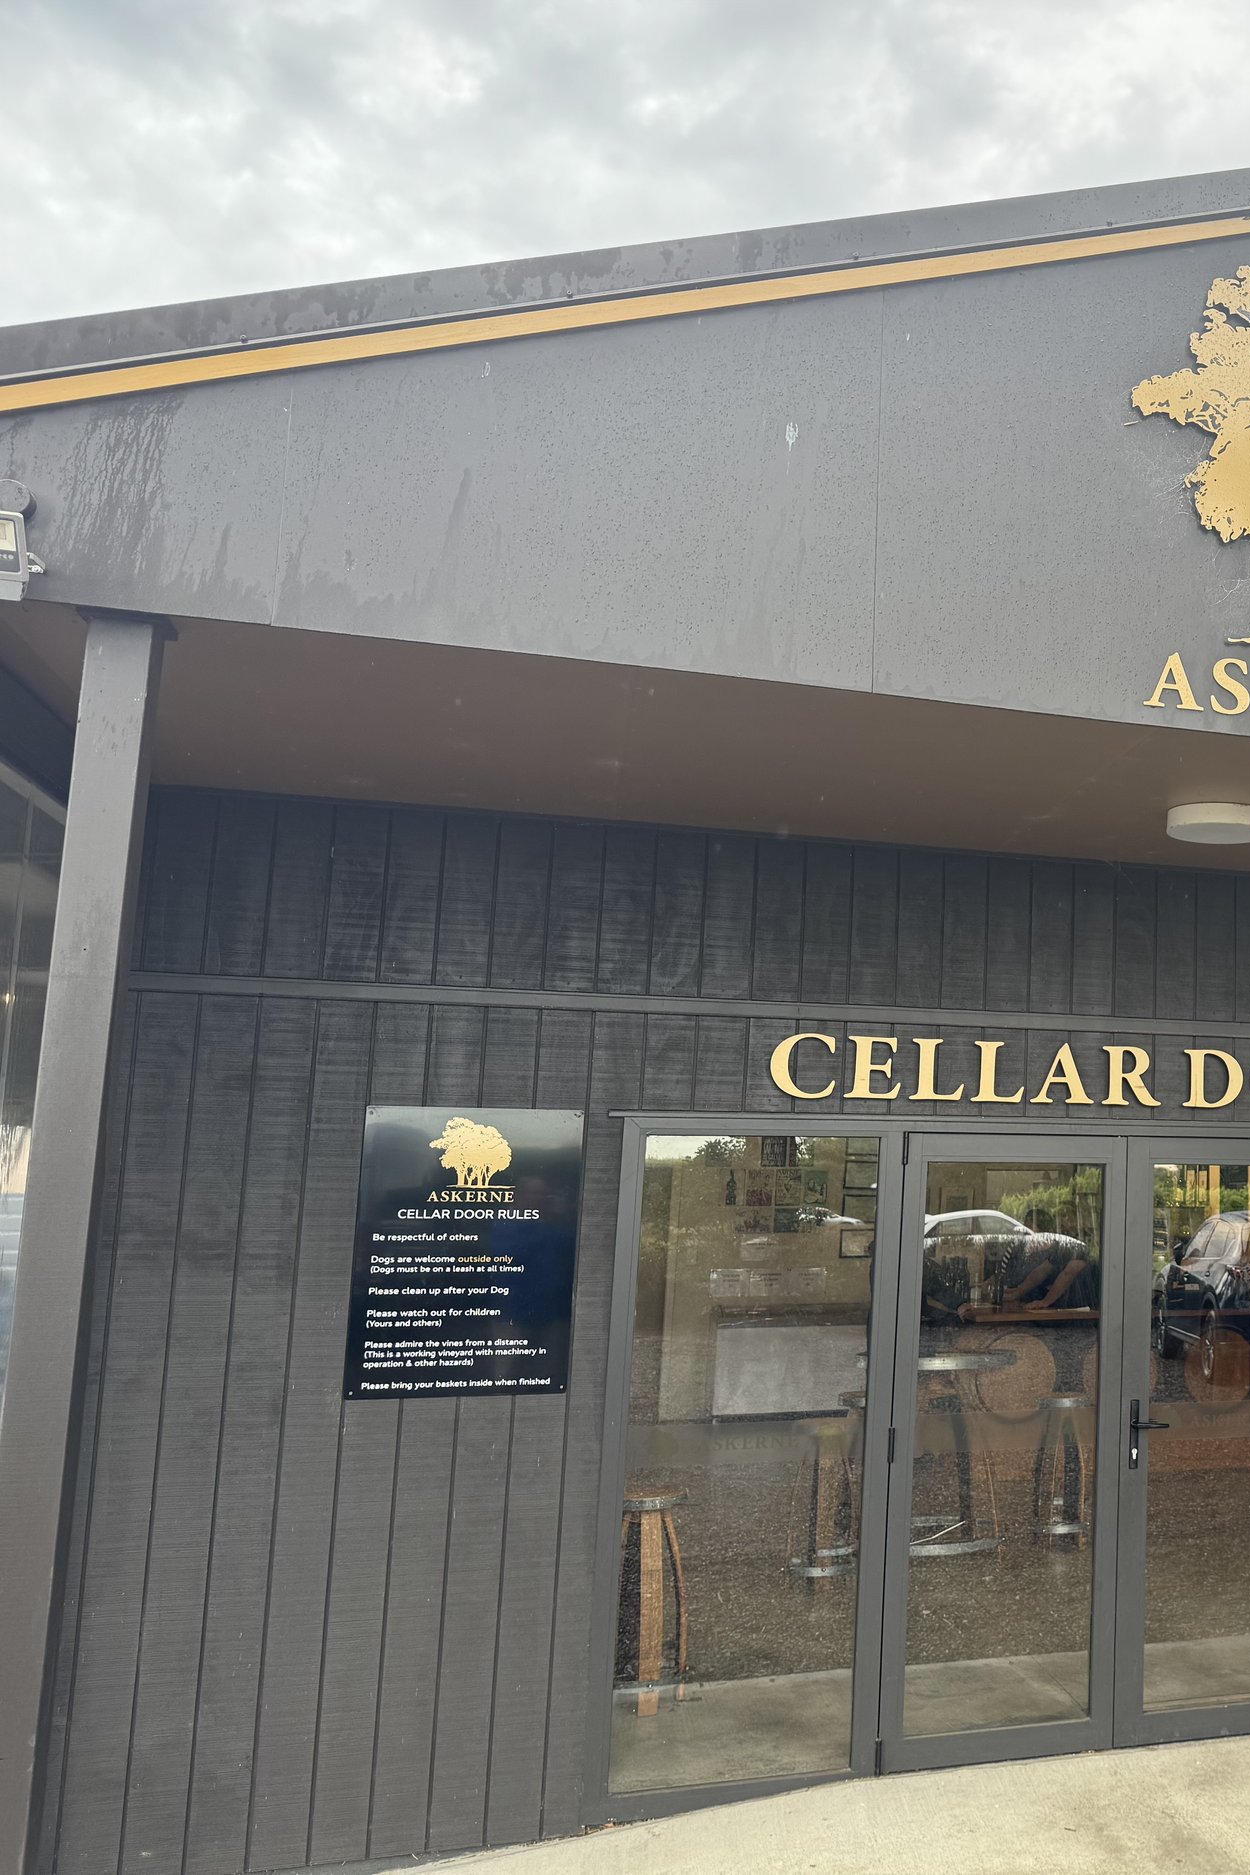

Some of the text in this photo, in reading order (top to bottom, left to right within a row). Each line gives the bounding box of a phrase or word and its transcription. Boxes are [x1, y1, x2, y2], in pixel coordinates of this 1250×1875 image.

[770, 1033, 1162, 1107] CELLAR
[426, 1190, 515, 1203] ASKERNE
[397, 1208, 540, 1220] CELLAR DOOR RULES
[372, 1232, 479, 1243] Be respectful of others
[370, 1255, 514, 1265] Dogs are welcome outside only
[370, 1265, 395, 1275] (Dogs
[419, 1265, 431, 1273] be
[452, 1264, 475, 1273] leash
[476, 1265, 486, 1273] at
[486, 1264, 498, 1273] all
[499, 1264, 525, 1274] times)
[368, 1285, 510, 1297] Please clean up after your Dog
[366, 1307, 501, 1318] Please watch out for children
[365, 1319, 443, 1329] (Yours and others)
[364, 1340, 393, 1349] Please
[394, 1340, 424, 1348] admire
[423, 1340, 440, 1348] the
[441, 1340, 464, 1348] vines
[464, 1339, 486, 1347] from
[493, 1338, 529, 1347] distance
[363, 1350, 385, 1360] (This
[386, 1350, 394, 1358] is
[402, 1350, 437, 1360] working
[437, 1349, 474, 1359] vineyard
[474, 1348, 494, 1356] with
[494, 1347, 538, 1357] machinery
[538, 1347, 547, 1355] in
[362, 1358, 474, 1370] operation & other hazards)
[360, 1377, 551, 1391] Please bring your baskets inside when finished
